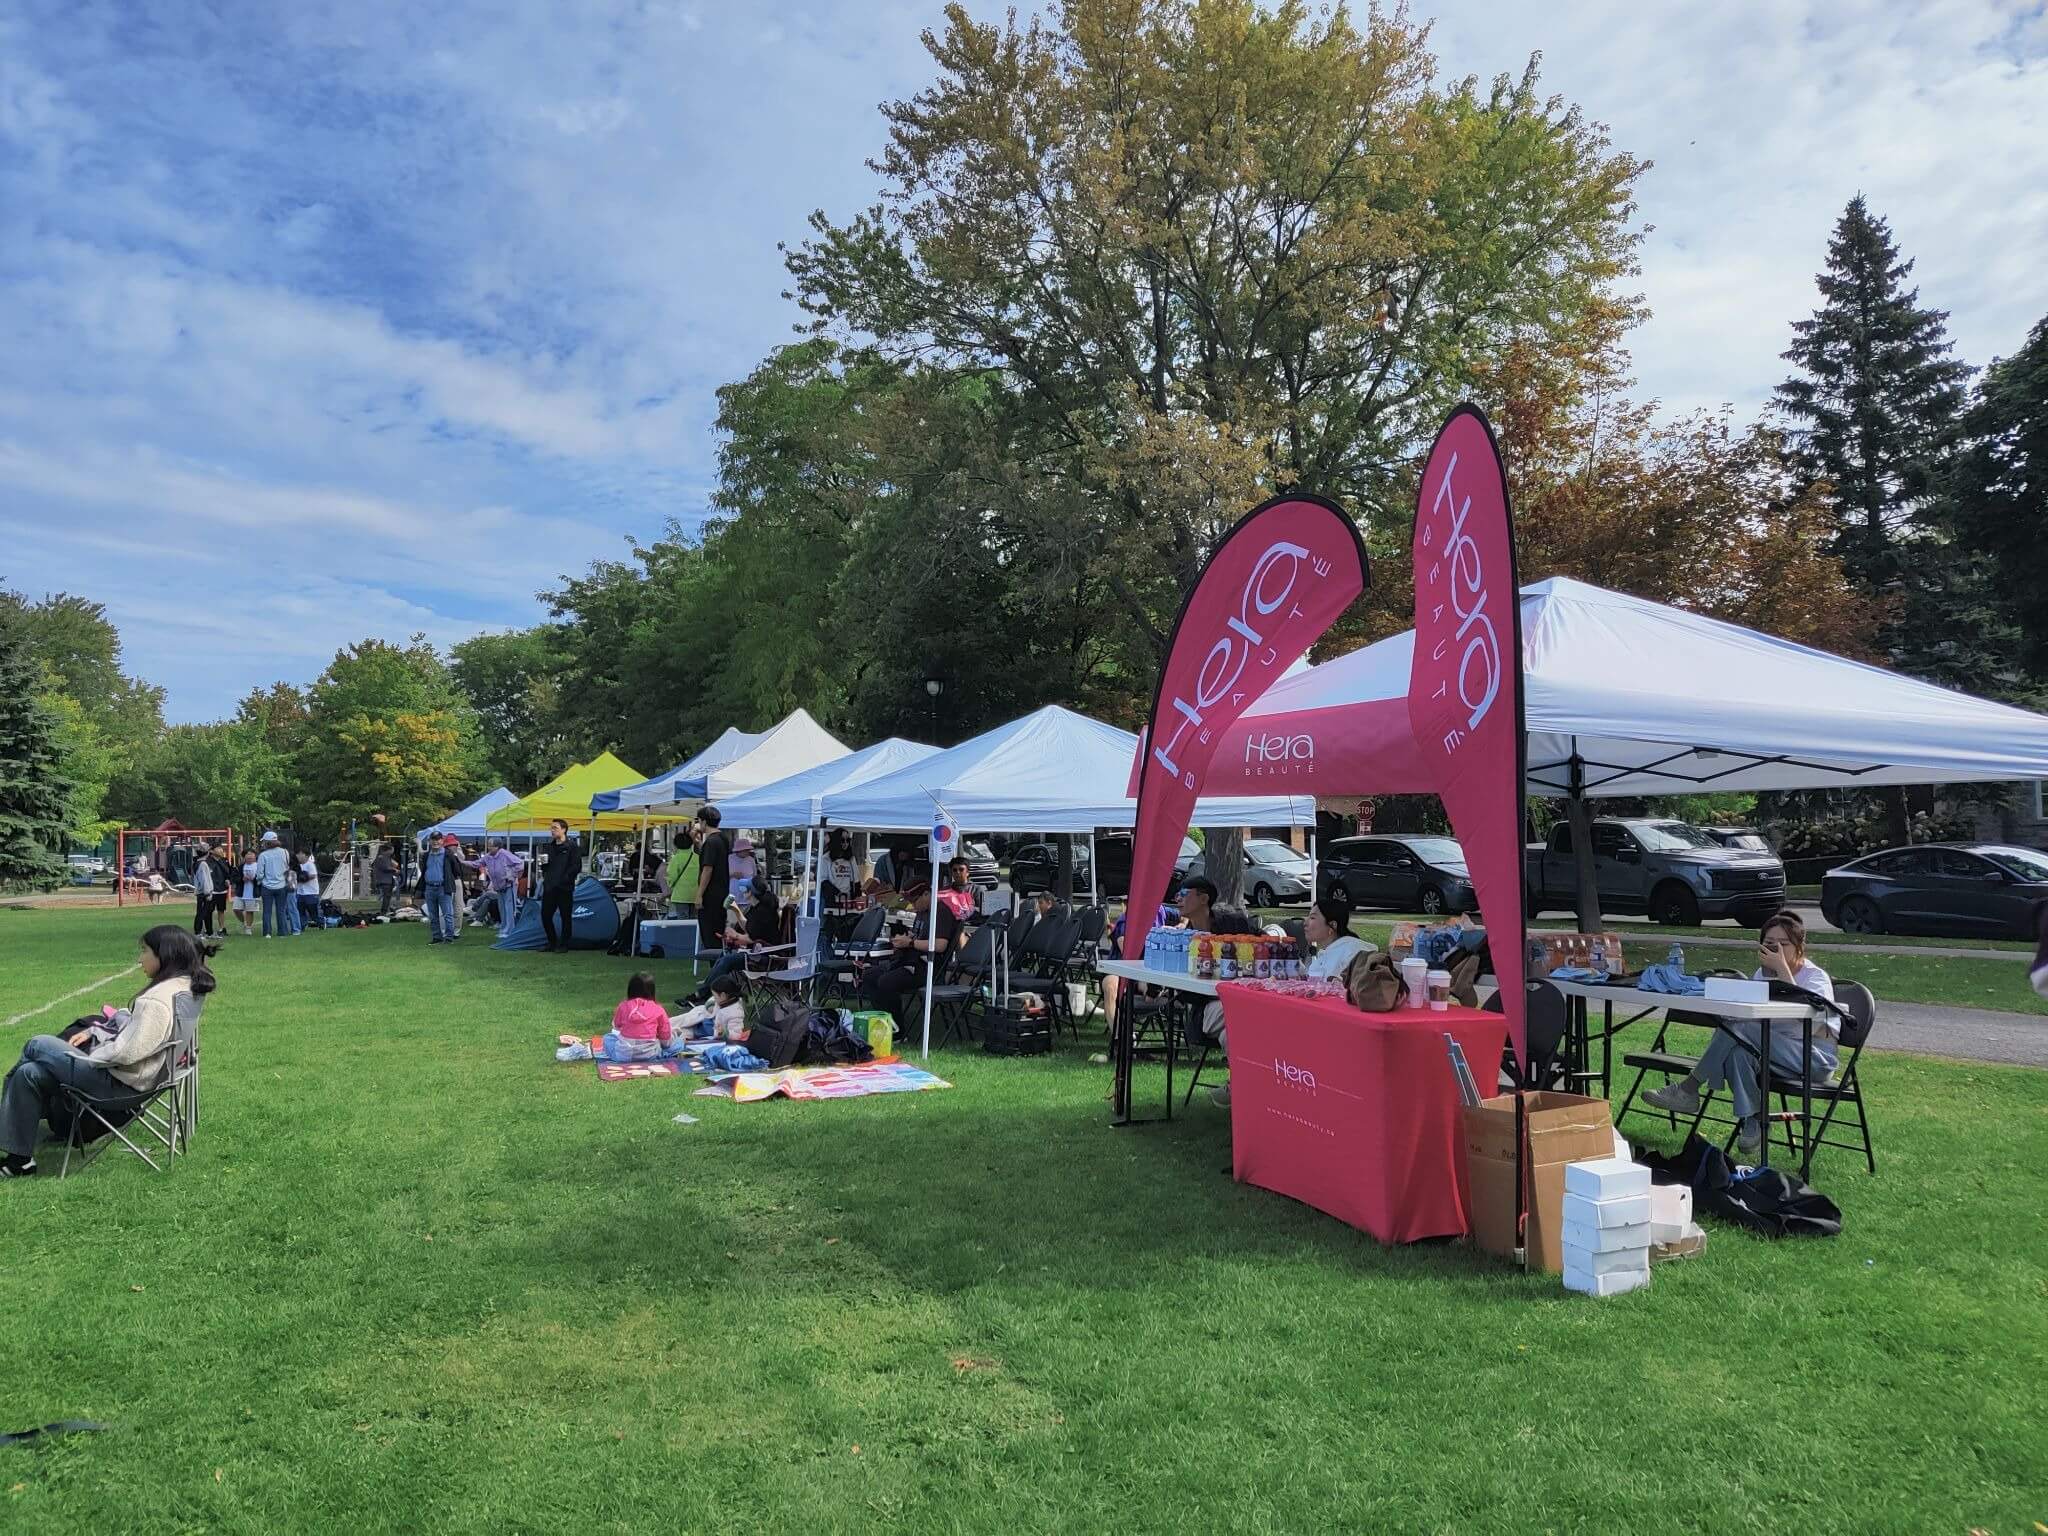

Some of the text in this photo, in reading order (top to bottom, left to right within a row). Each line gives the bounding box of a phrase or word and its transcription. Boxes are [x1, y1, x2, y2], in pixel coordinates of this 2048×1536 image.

[1423, 524, 1465, 754] BEAUTÉ
[1433, 451, 1501, 730] Hera
[1154, 541, 1310, 778] Hera
[1184, 555, 1331, 791] BEAUTÉ
[1245, 733, 1314, 763] Hera
[1245, 761, 1315, 776] BEAUTÉ
[1356, 806, 1375, 815] STOP
[1274, 1057, 1316, 1089] Hera
